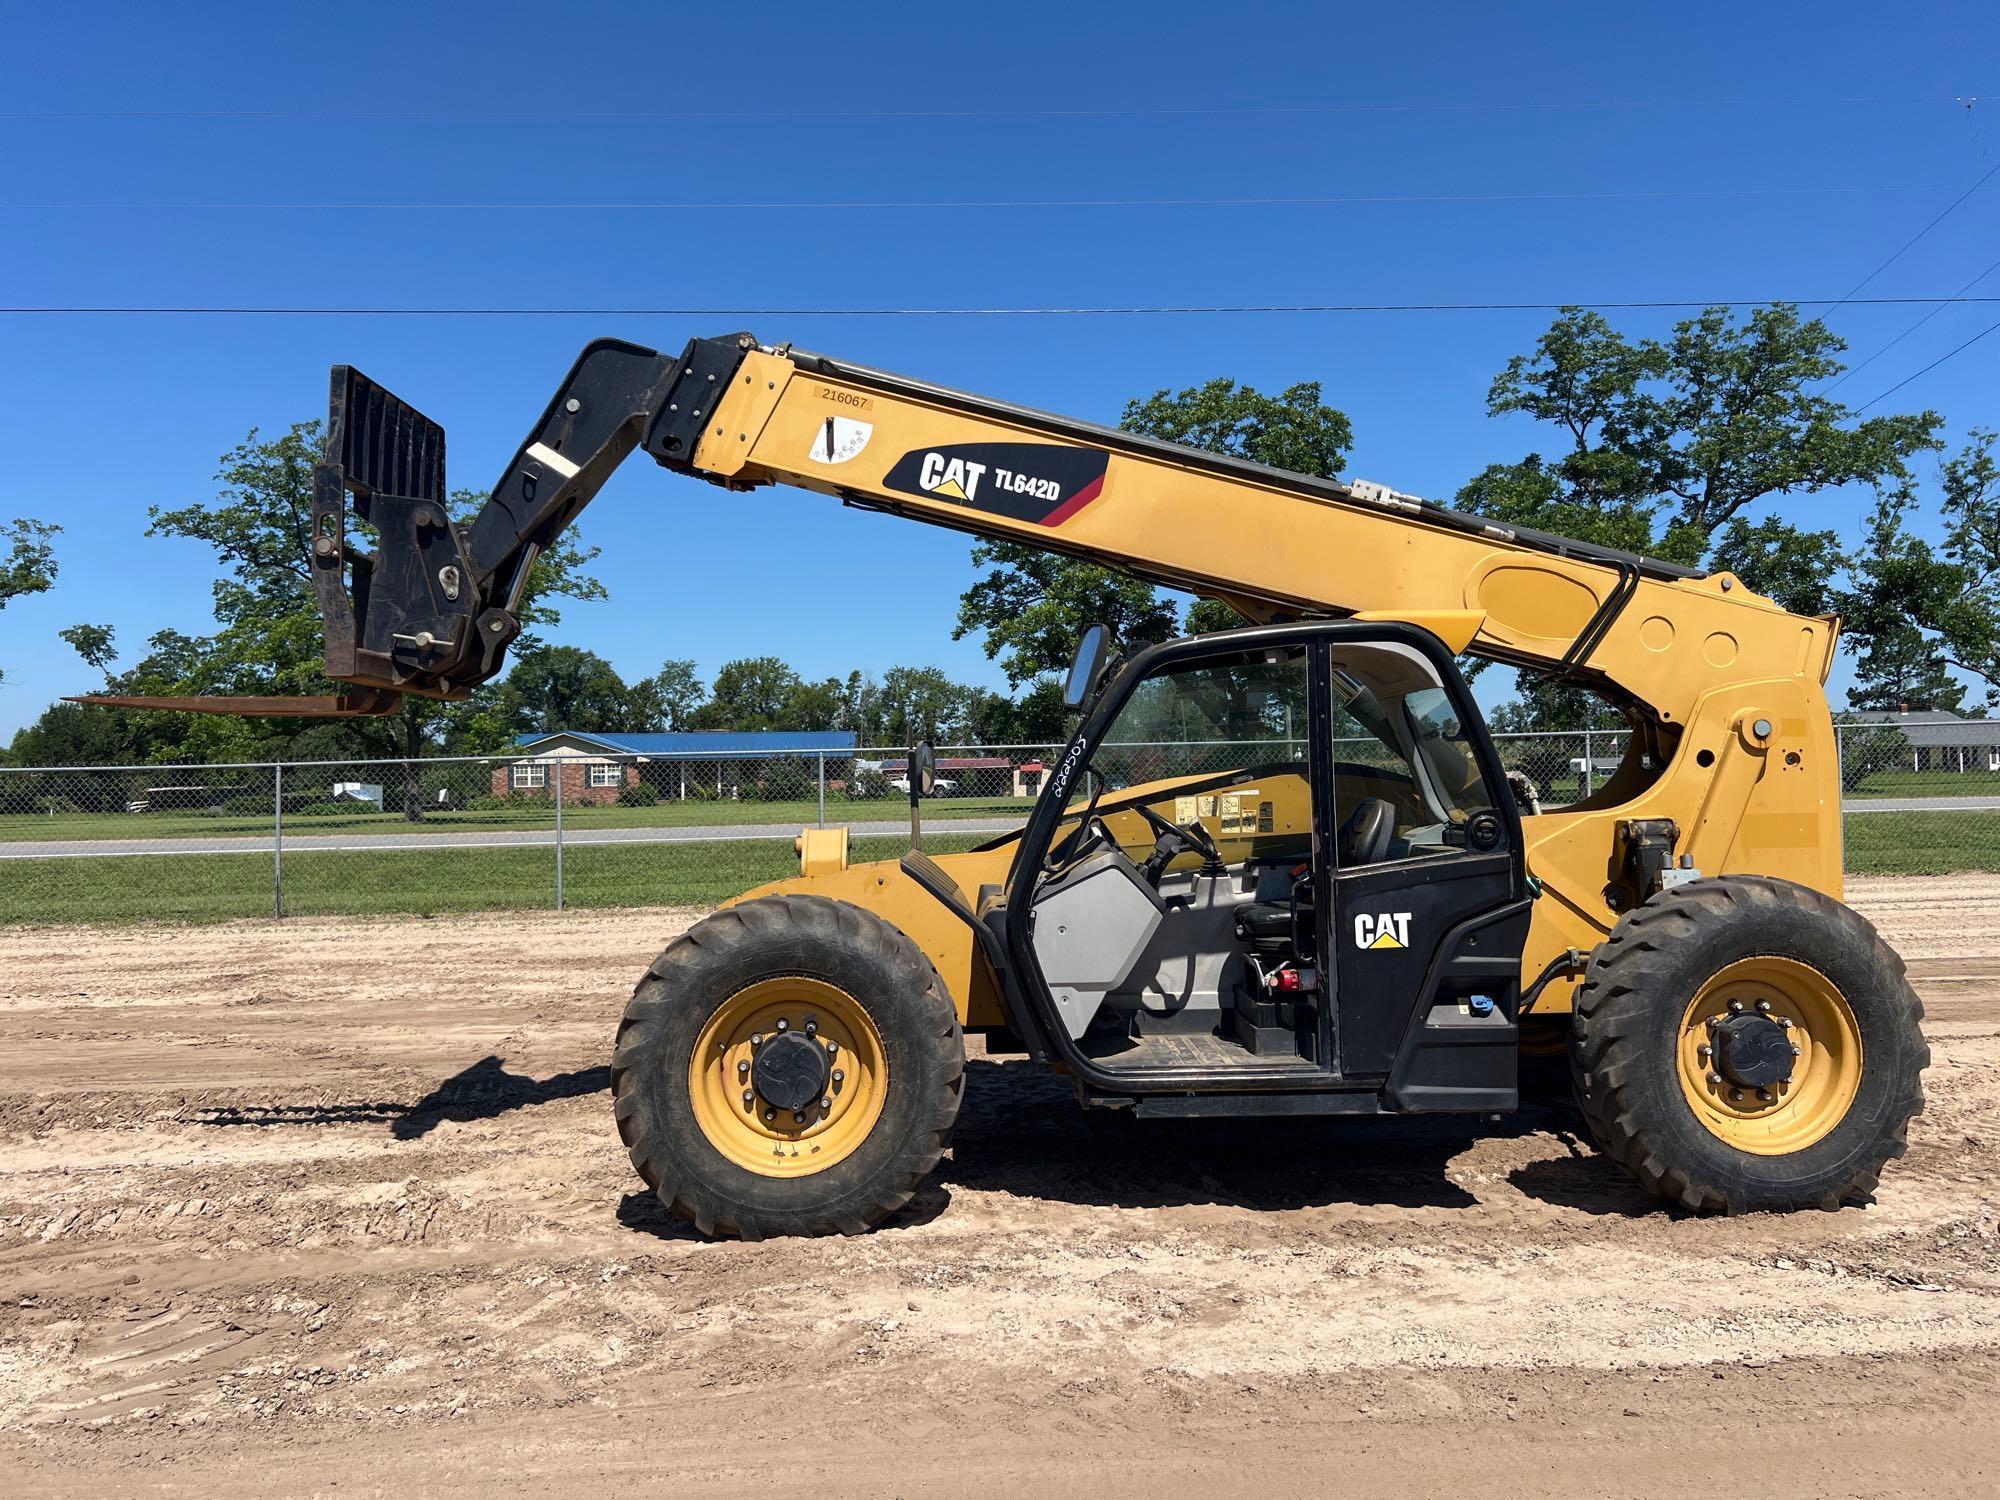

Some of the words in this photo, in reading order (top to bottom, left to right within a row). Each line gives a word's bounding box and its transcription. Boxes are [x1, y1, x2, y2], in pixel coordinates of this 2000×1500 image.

[822, 388, 868, 408] 216067
[919, 452, 987, 501] CAT
[995, 468, 1060, 501] TL642D
[1354, 912, 1412, 950] CAT
